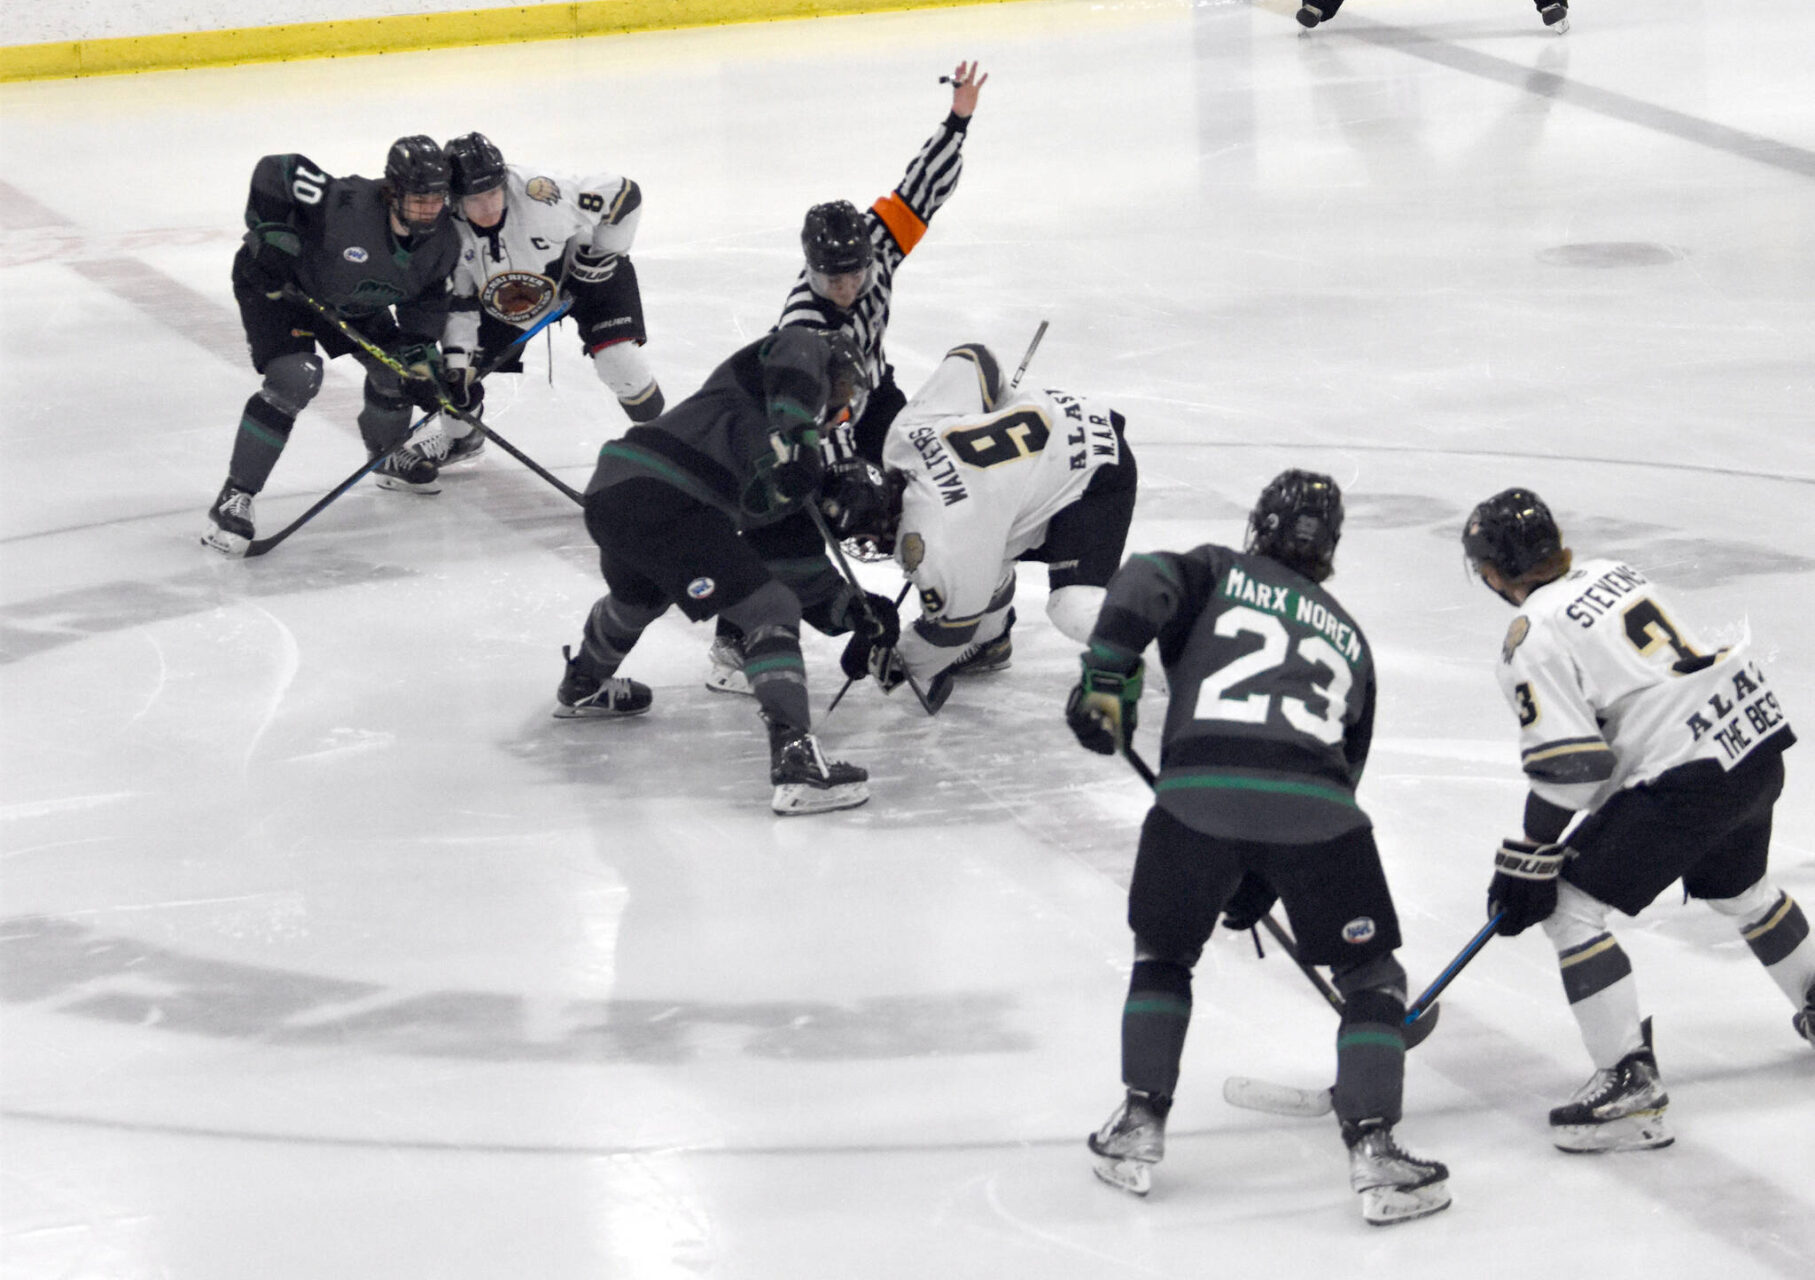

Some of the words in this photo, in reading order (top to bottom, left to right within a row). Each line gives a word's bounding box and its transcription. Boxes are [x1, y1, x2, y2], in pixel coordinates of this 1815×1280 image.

[292, 165, 327, 205] 10
[578, 192, 604, 213] 8
[531, 237, 550, 251] C
[909, 426, 969, 508] WALTERS
[920, 586, 944, 613] 9
[1225, 568, 1291, 614] MARX
[1297, 594, 1362, 663] NOREN
[1193, 605, 1354, 746] 23
[1514, 681, 1539, 729] 3
[1713, 716, 1752, 760] THE
